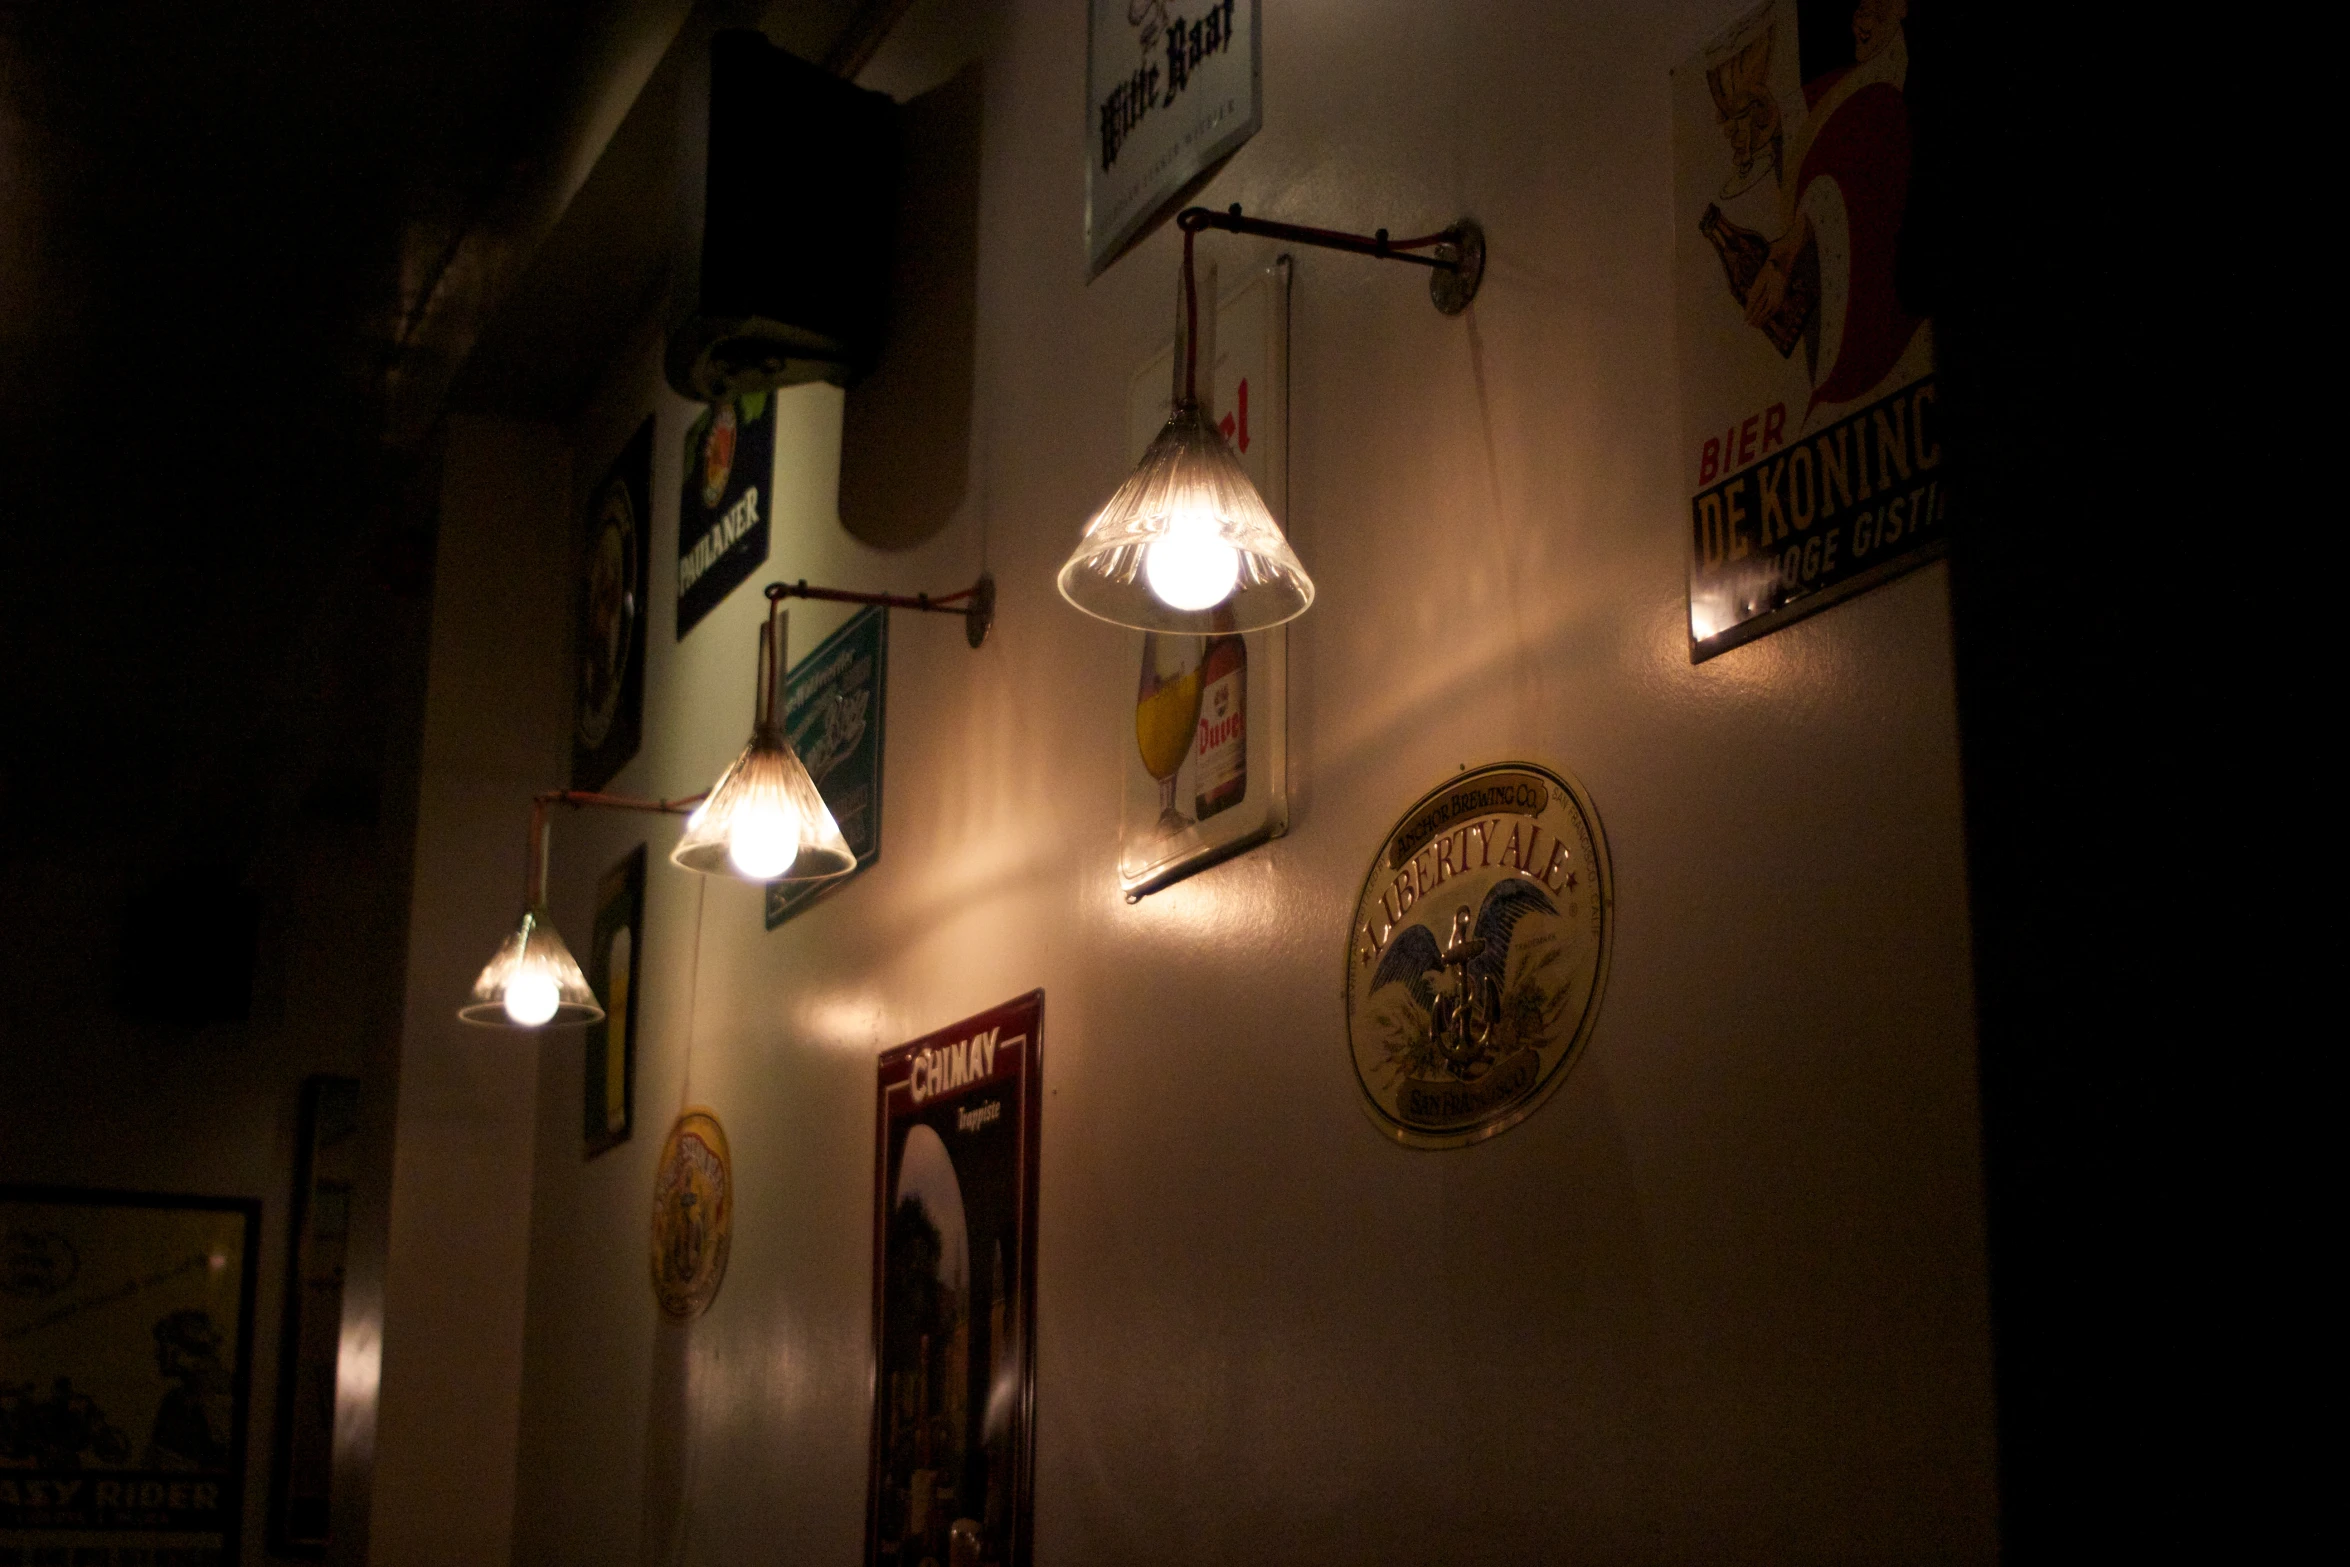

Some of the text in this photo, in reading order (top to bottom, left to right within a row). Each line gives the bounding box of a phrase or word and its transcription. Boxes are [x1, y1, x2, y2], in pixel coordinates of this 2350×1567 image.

[1699, 401, 1786, 487] BIER
[679, 484, 761, 599] PAULANER
[1700, 477, 1749, 569] DE
[1399, 804, 1448, 852] ANCHOR
[1450, 784, 1515, 817] BREWING
[1363, 818, 1571, 954] LIBERTY ALE
[911, 1026, 1000, 1104] CHIMAY
[1411, 1089, 1440, 1116] SAN
[95, 1479, 220, 1511] RIDER
